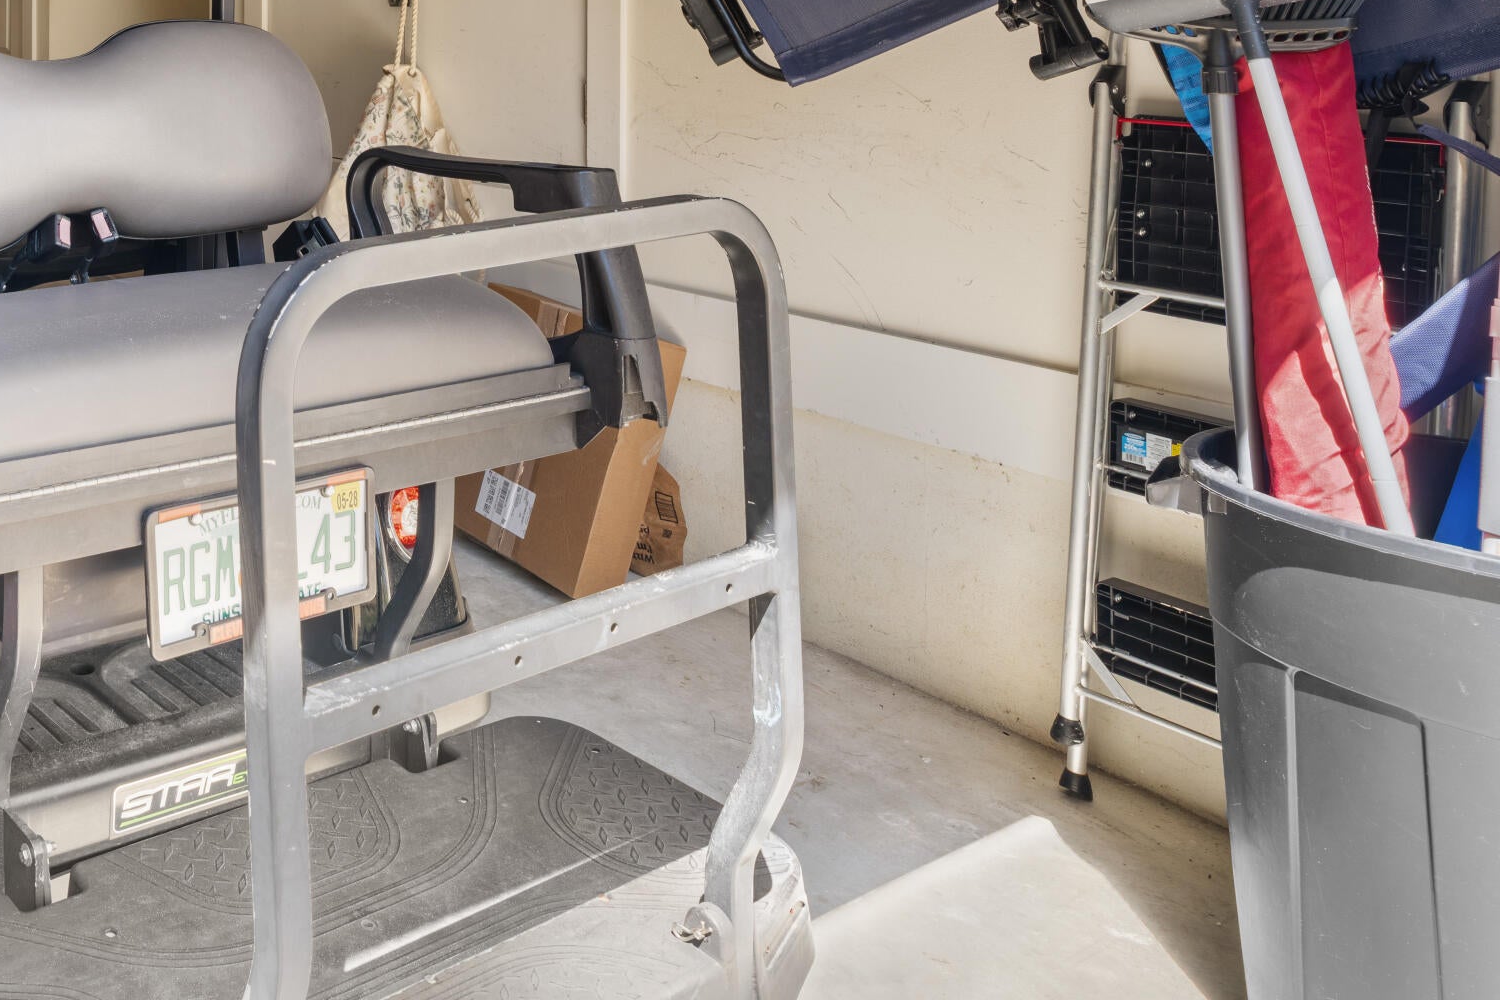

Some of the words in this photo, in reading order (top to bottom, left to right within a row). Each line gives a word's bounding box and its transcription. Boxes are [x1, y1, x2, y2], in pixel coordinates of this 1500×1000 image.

[336, 490, 358, 510] 05-28
[298, 510, 356, 580] 43
[202, 603, 241, 625] SUNS
